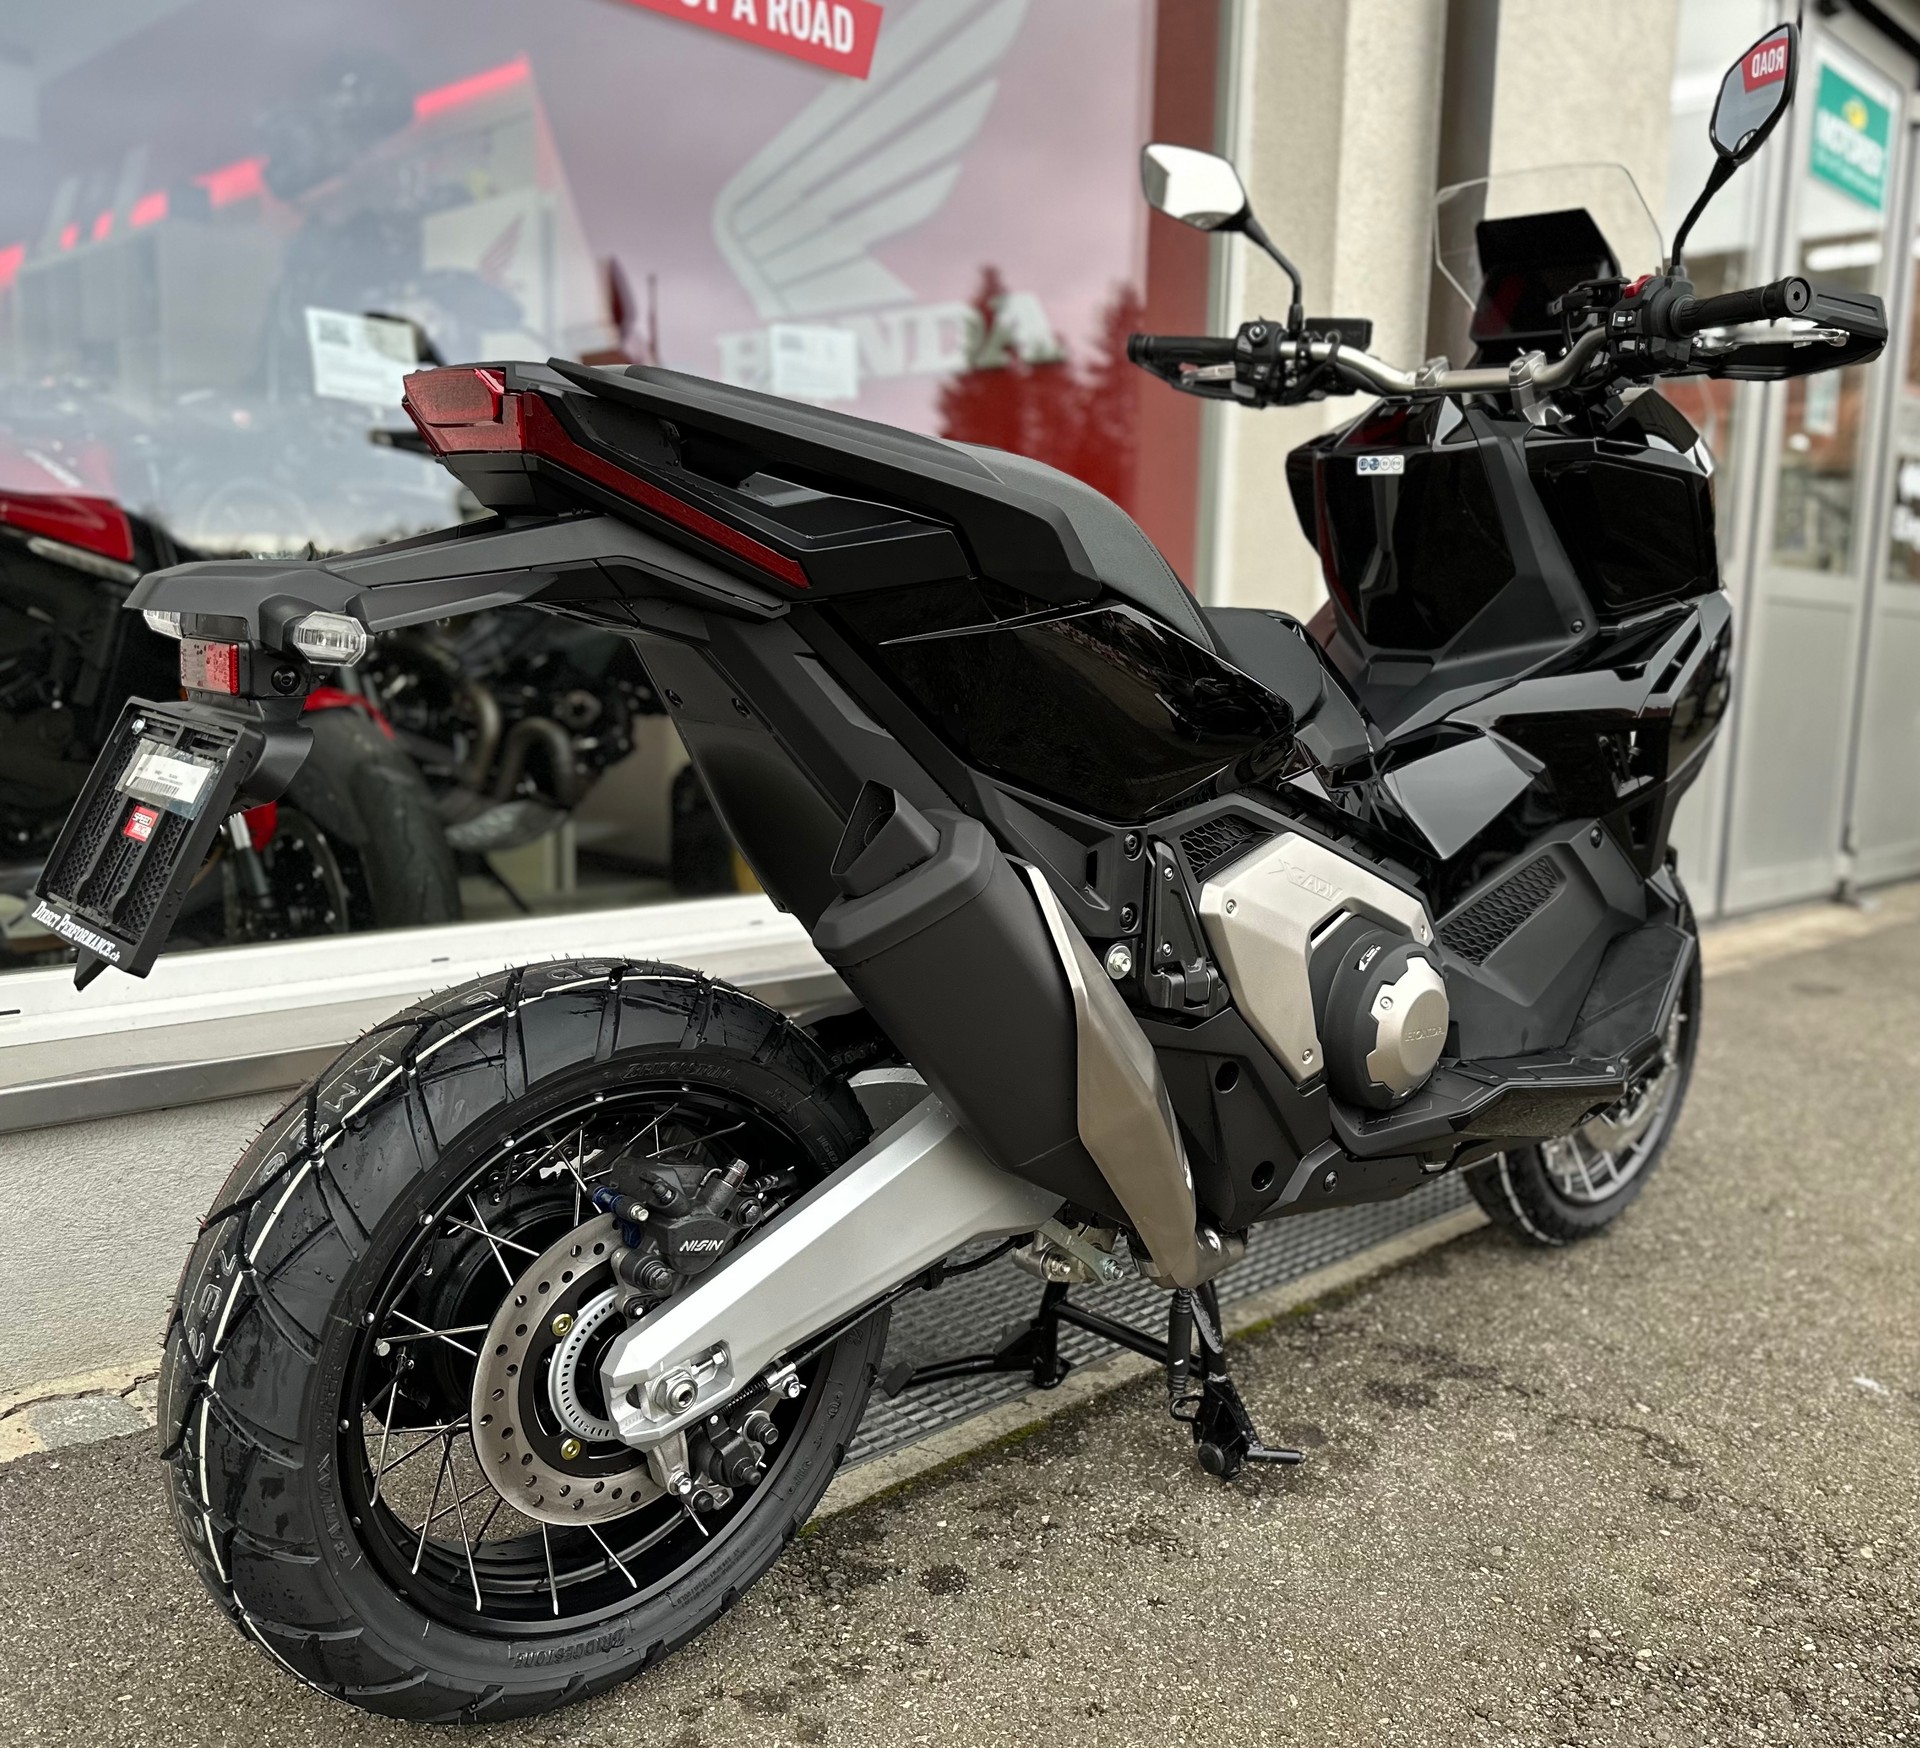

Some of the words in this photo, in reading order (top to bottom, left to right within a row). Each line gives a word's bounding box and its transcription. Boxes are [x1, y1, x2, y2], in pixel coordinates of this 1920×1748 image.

[766, 0, 855, 54] ROAD
[717, 292, 1067, 390] HNDA
[1404, 1025, 1444, 1043] HONDA
